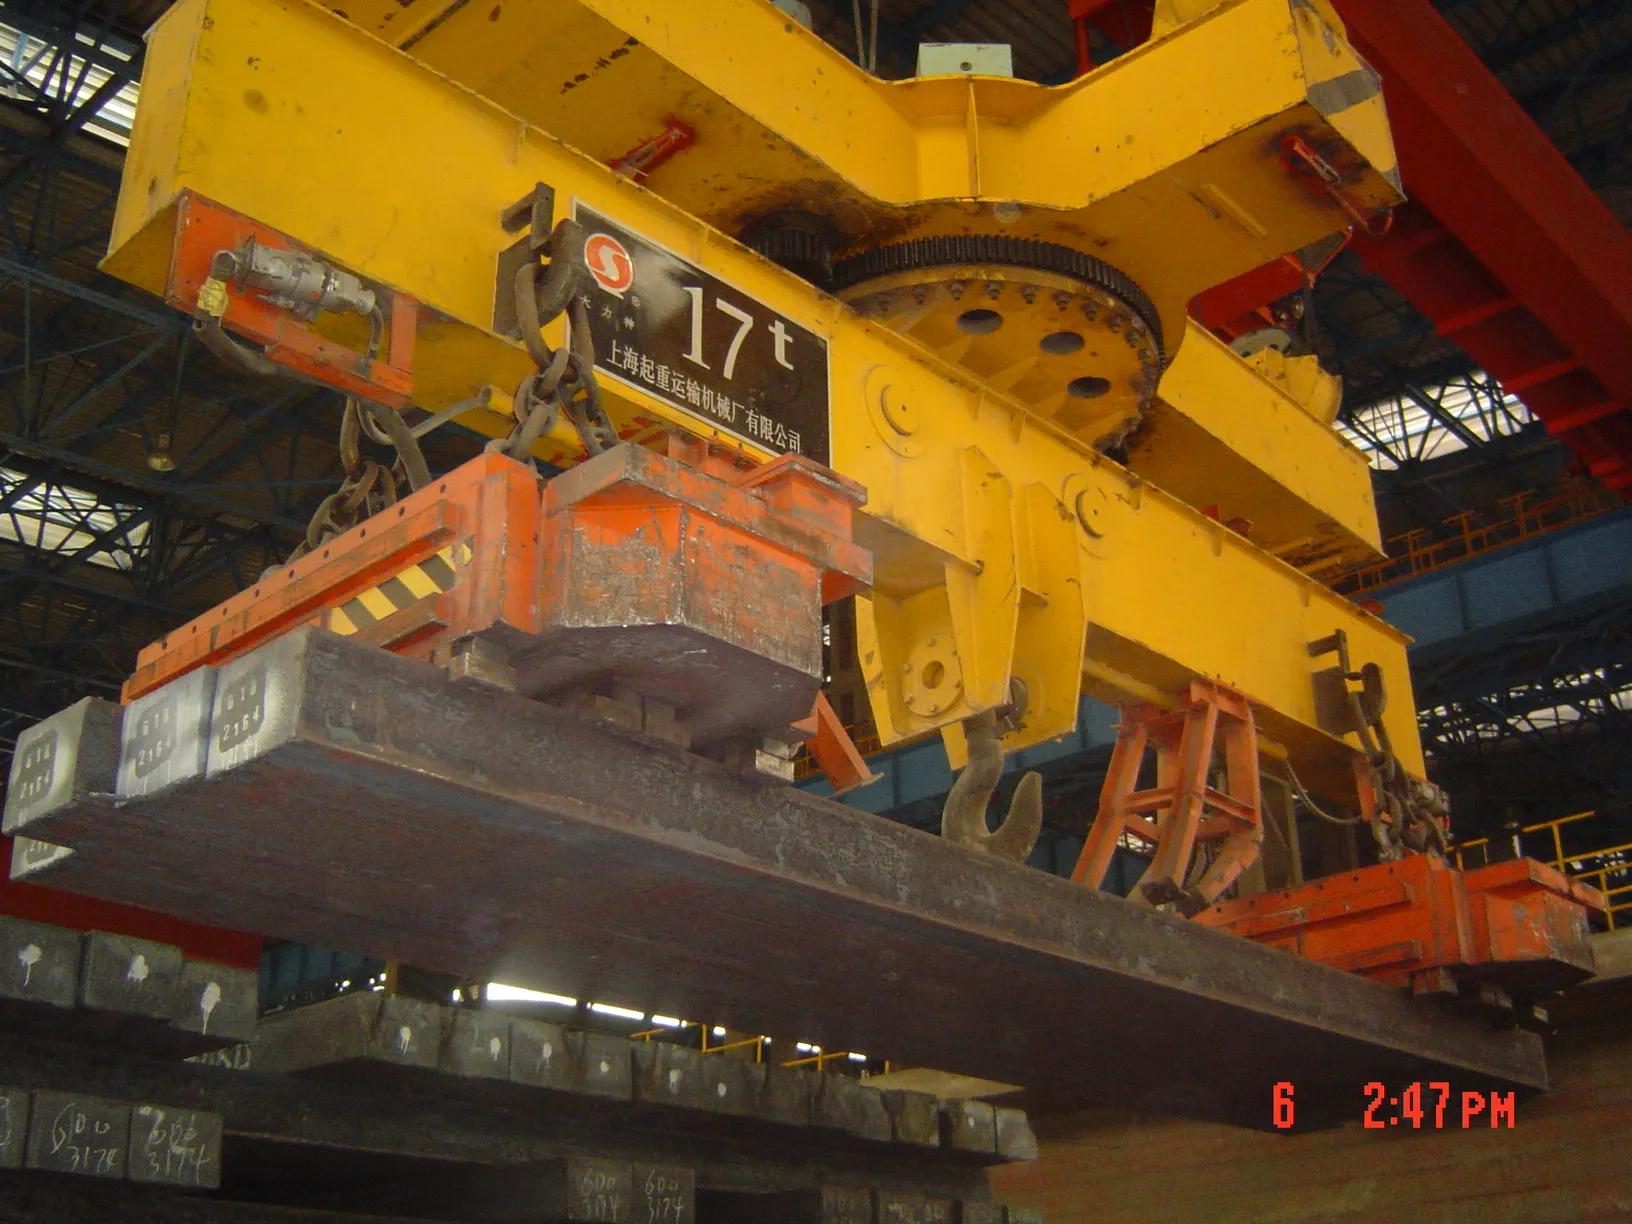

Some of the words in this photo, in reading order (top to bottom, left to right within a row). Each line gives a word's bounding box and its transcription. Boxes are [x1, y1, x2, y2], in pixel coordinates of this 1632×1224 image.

[579, 294, 636, 331] 大力神
[605, 339, 802, 455] 上海起重运输机械厂有限公司
[222, 703, 260, 741] 2164
